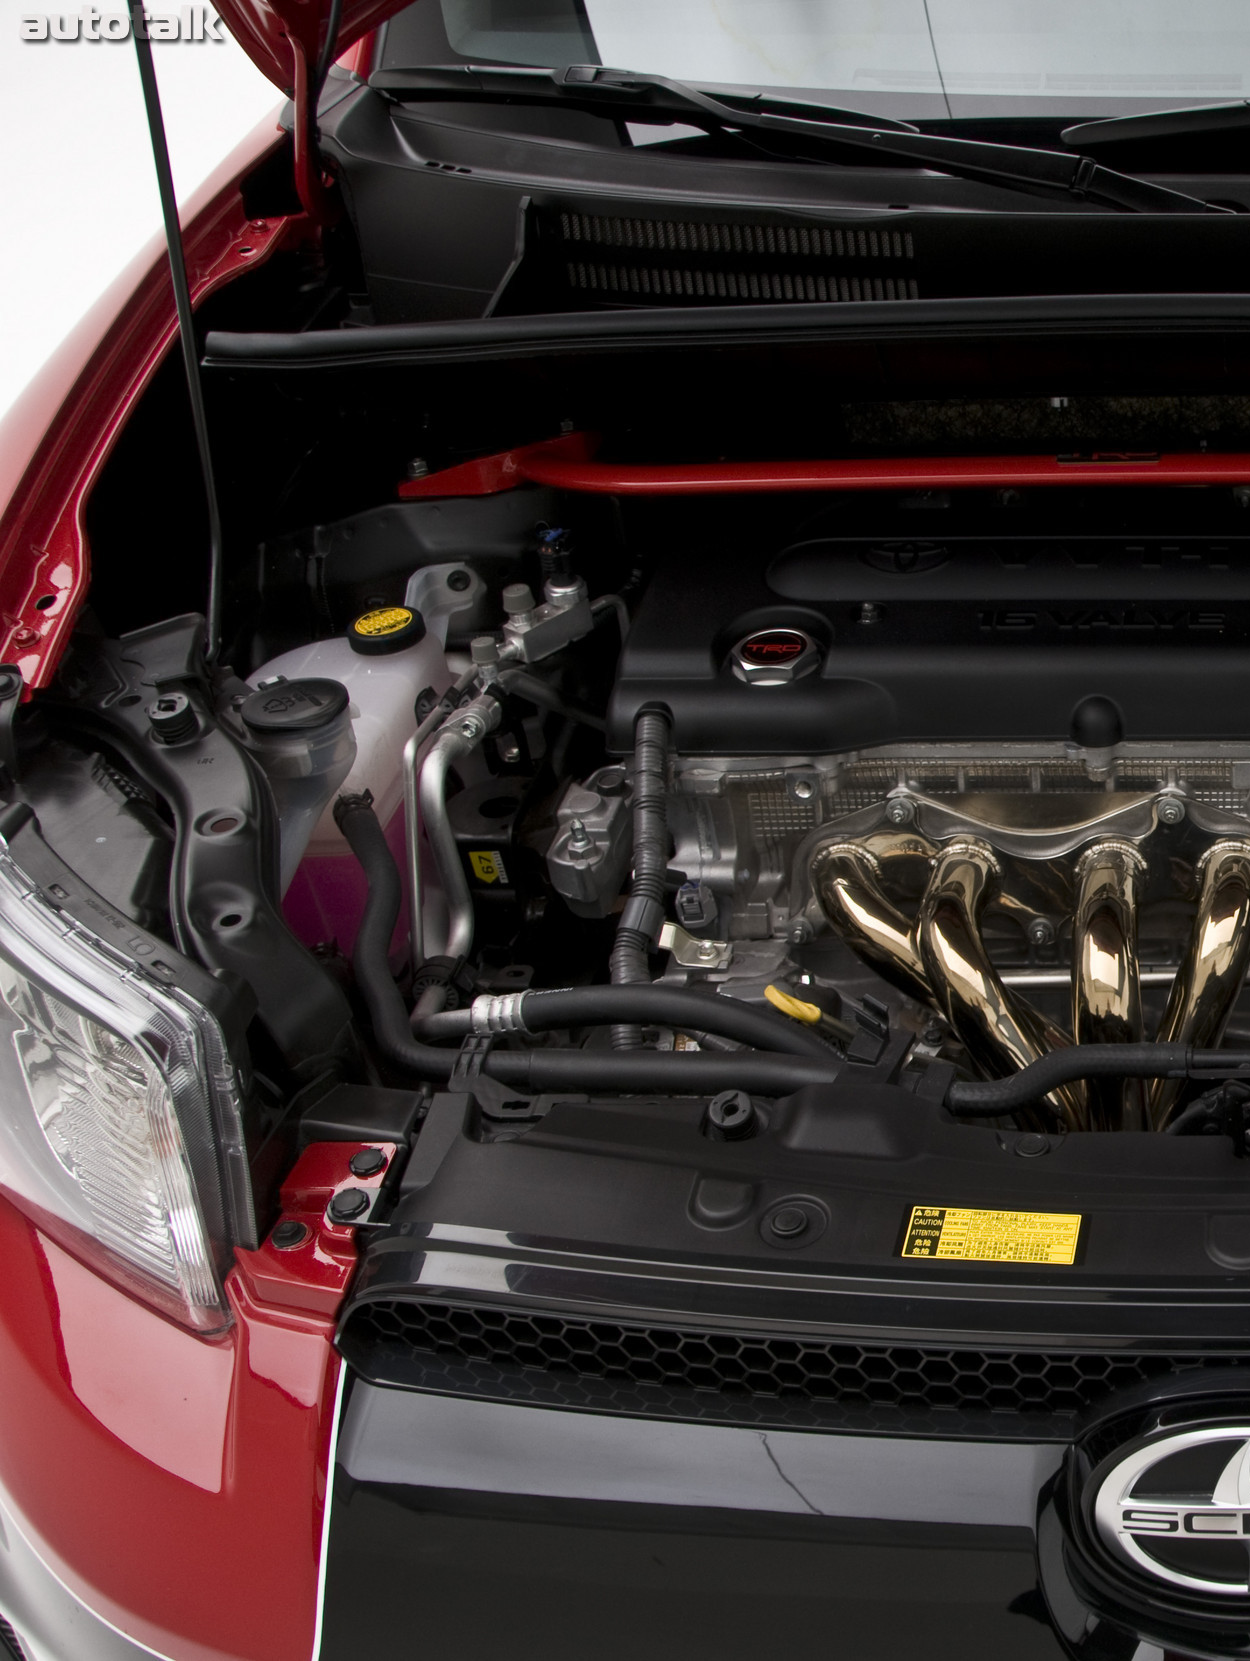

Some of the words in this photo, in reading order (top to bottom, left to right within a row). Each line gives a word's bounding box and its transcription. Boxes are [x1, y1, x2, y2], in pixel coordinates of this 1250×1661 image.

[1048, 610, 1226, 630] VALVE
[747, 644, 801, 654] TRD
[914, 1218, 943, 1226] CAUTION
[911, 1229, 940, 1237] ATTENTION
